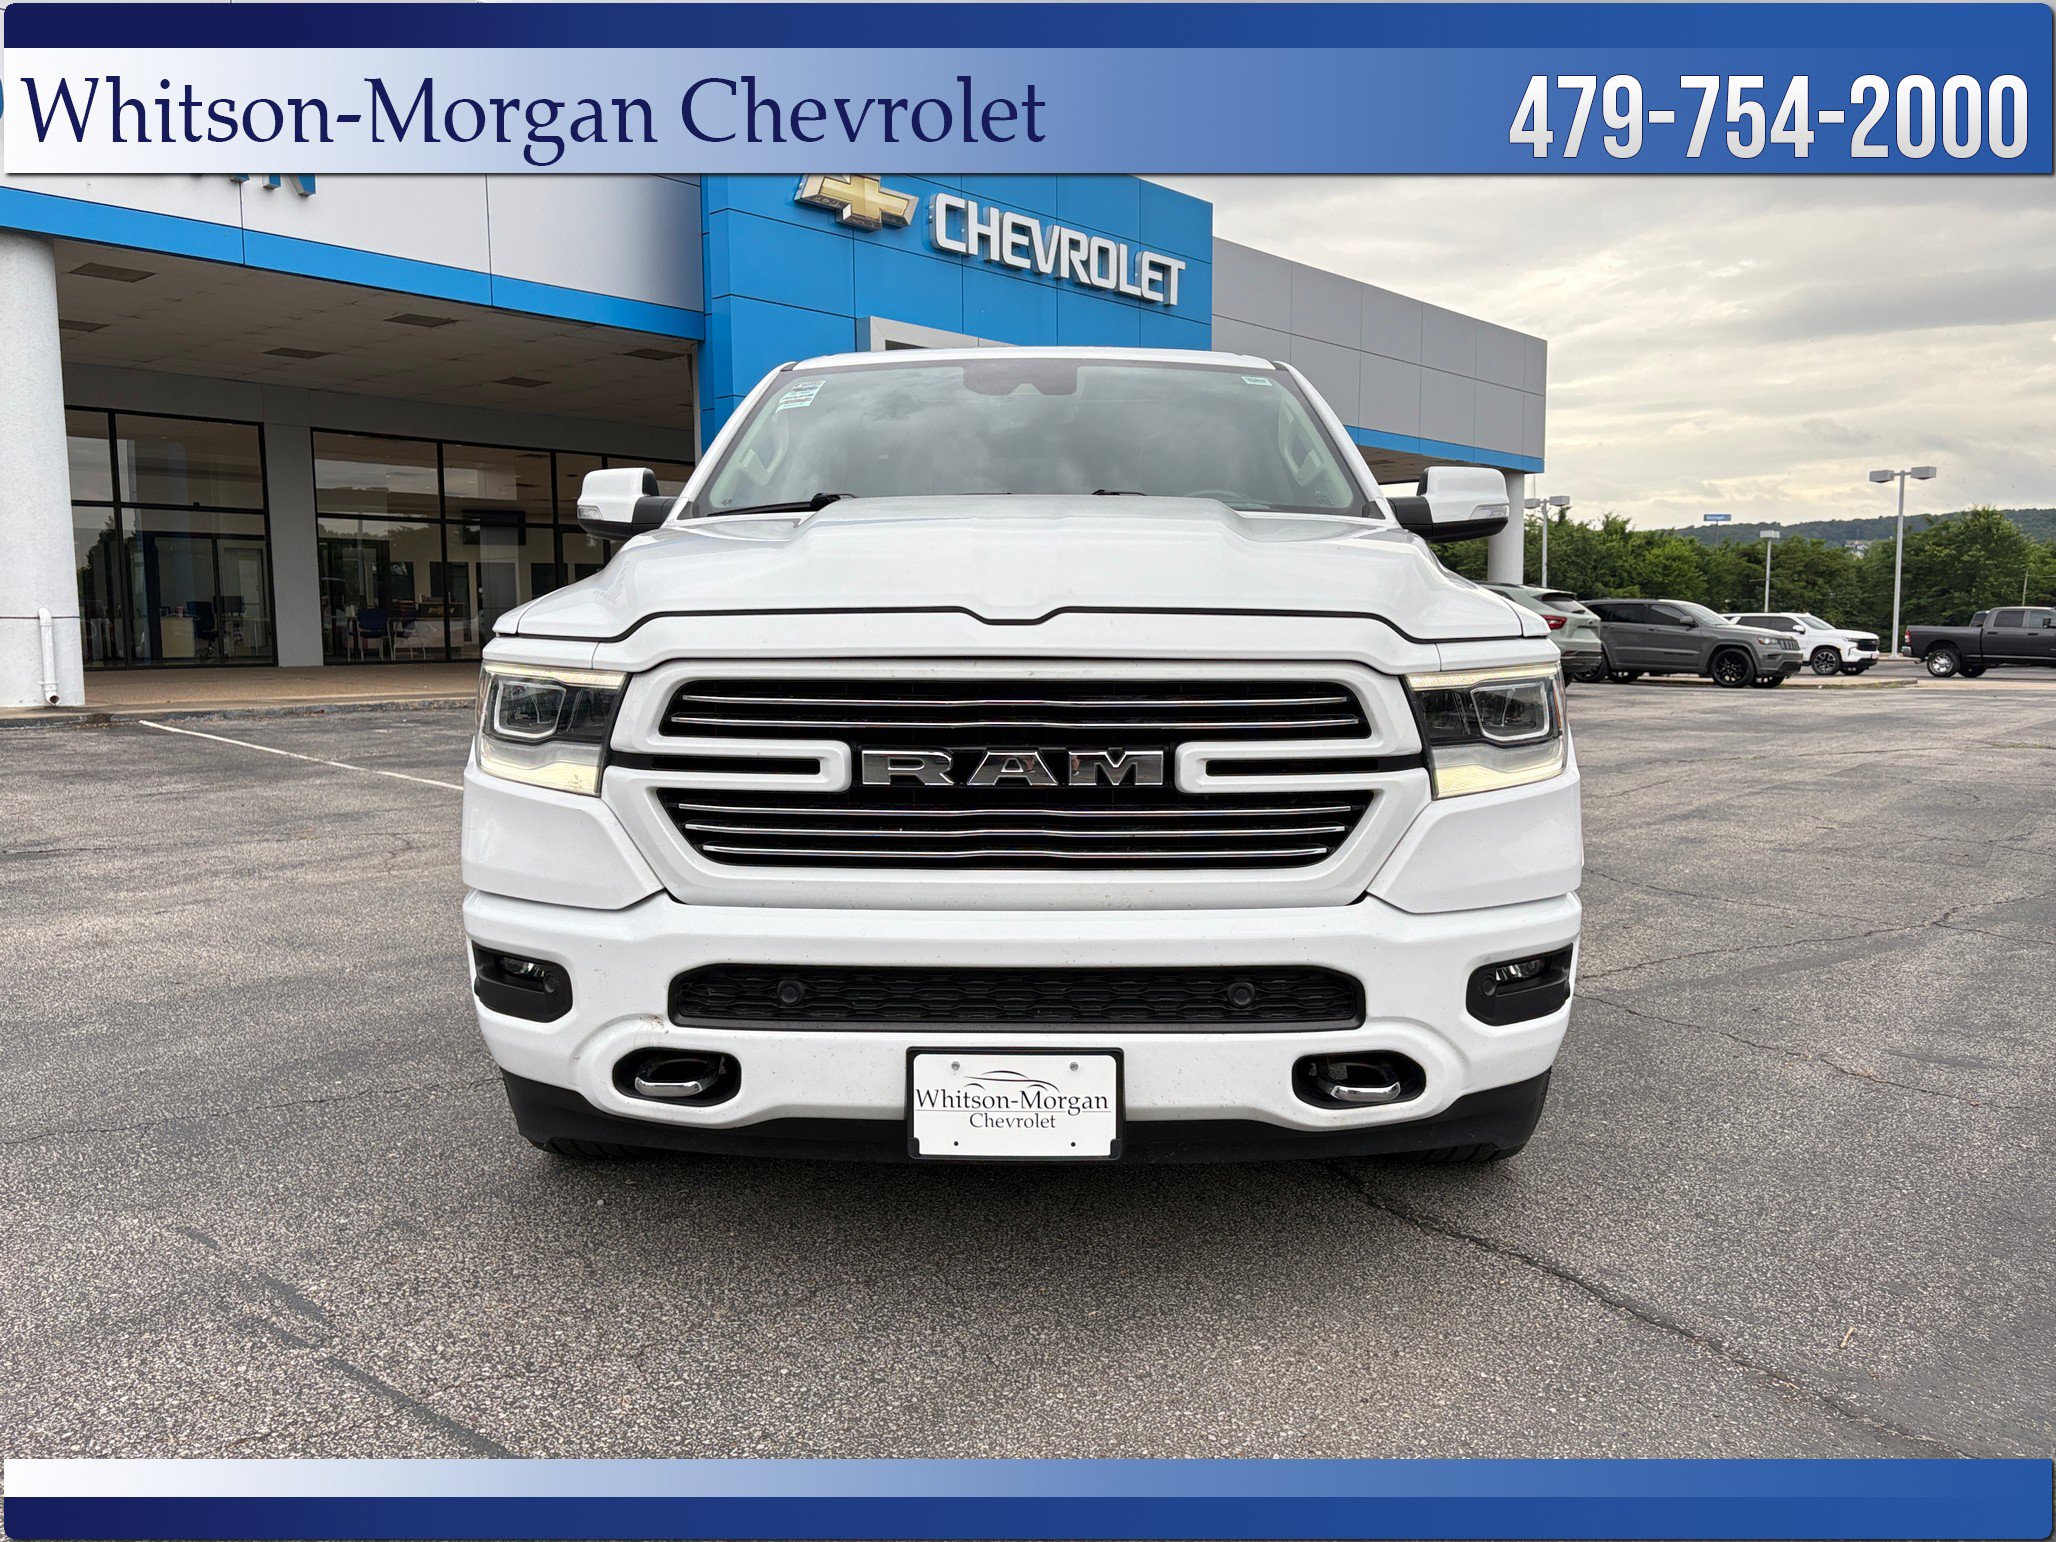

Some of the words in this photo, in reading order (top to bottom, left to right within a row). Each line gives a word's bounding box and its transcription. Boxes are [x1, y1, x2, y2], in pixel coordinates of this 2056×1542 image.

[931, 192, 1187, 306] CHEVROLET
[861, 749, 1165, 786] RAM
[915, 1088, 1109, 1116] Whitson-Morgan
[969, 1112, 1056, 1129] Chevrolet
